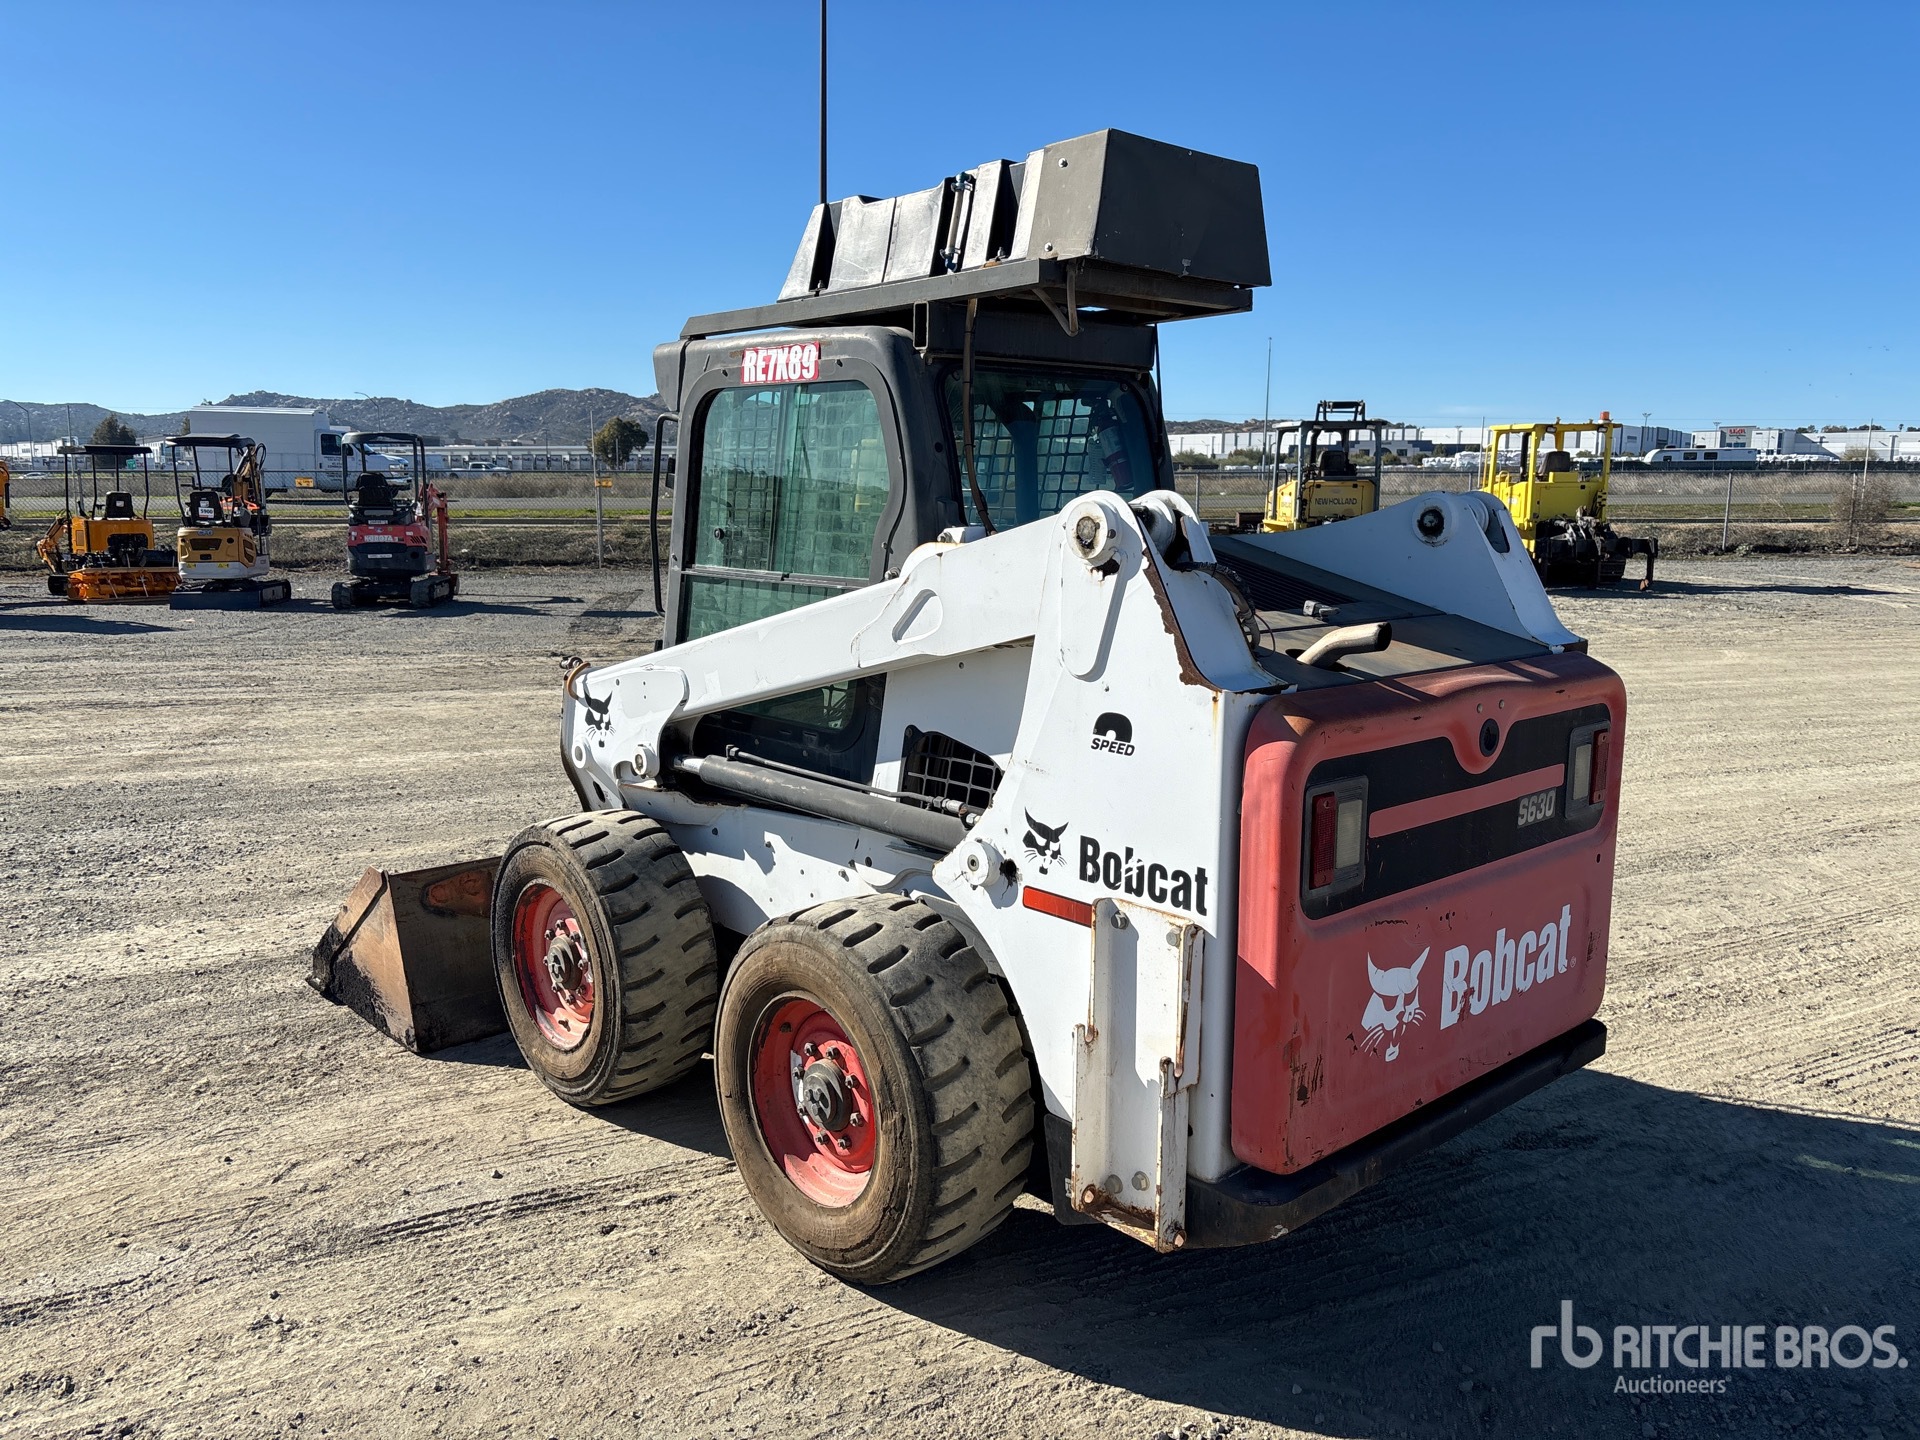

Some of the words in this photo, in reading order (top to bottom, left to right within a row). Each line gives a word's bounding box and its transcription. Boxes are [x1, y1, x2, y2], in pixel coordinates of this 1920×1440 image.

[1315, 497, 1328, 505] NEW
[1329, 497, 1357, 505] HOLLAND
[1091, 738, 1135, 756] SPEED
[1517, 790, 1556, 826] S630
[1079, 835, 1208, 917] Bobcat
[1440, 903, 1572, 1031] Bobcat
